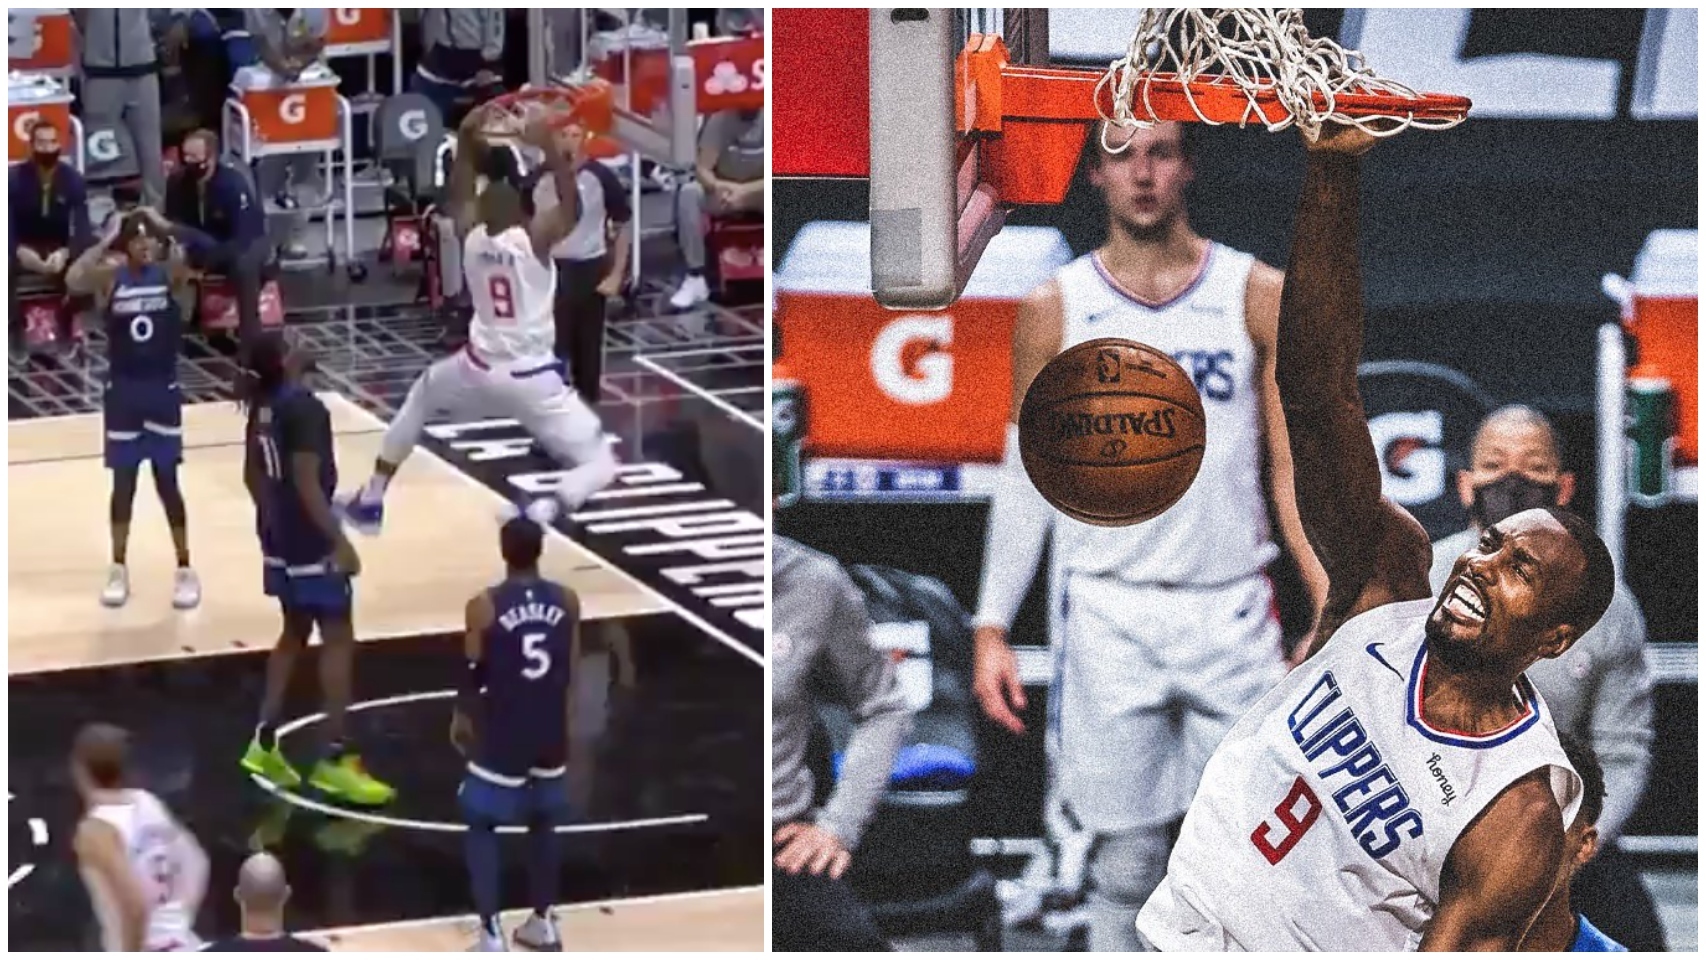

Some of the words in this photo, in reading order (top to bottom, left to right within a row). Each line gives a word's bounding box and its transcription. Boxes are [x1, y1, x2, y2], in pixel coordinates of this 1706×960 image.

[279, 94, 306, 124] G
[400, 110, 428, 140] G
[88, 130, 122, 161] G
[487, 273, 516, 319] 9
[131, 315, 154, 342] 0
[870, 315, 954, 404] G
[1367, 409, 1446, 506] G
[521, 633, 552, 681] 5
[1287, 669, 1424, 861] CLIPPERS
[1425, 752, 1457, 807] honey
[1250, 775, 1323, 866] 9
